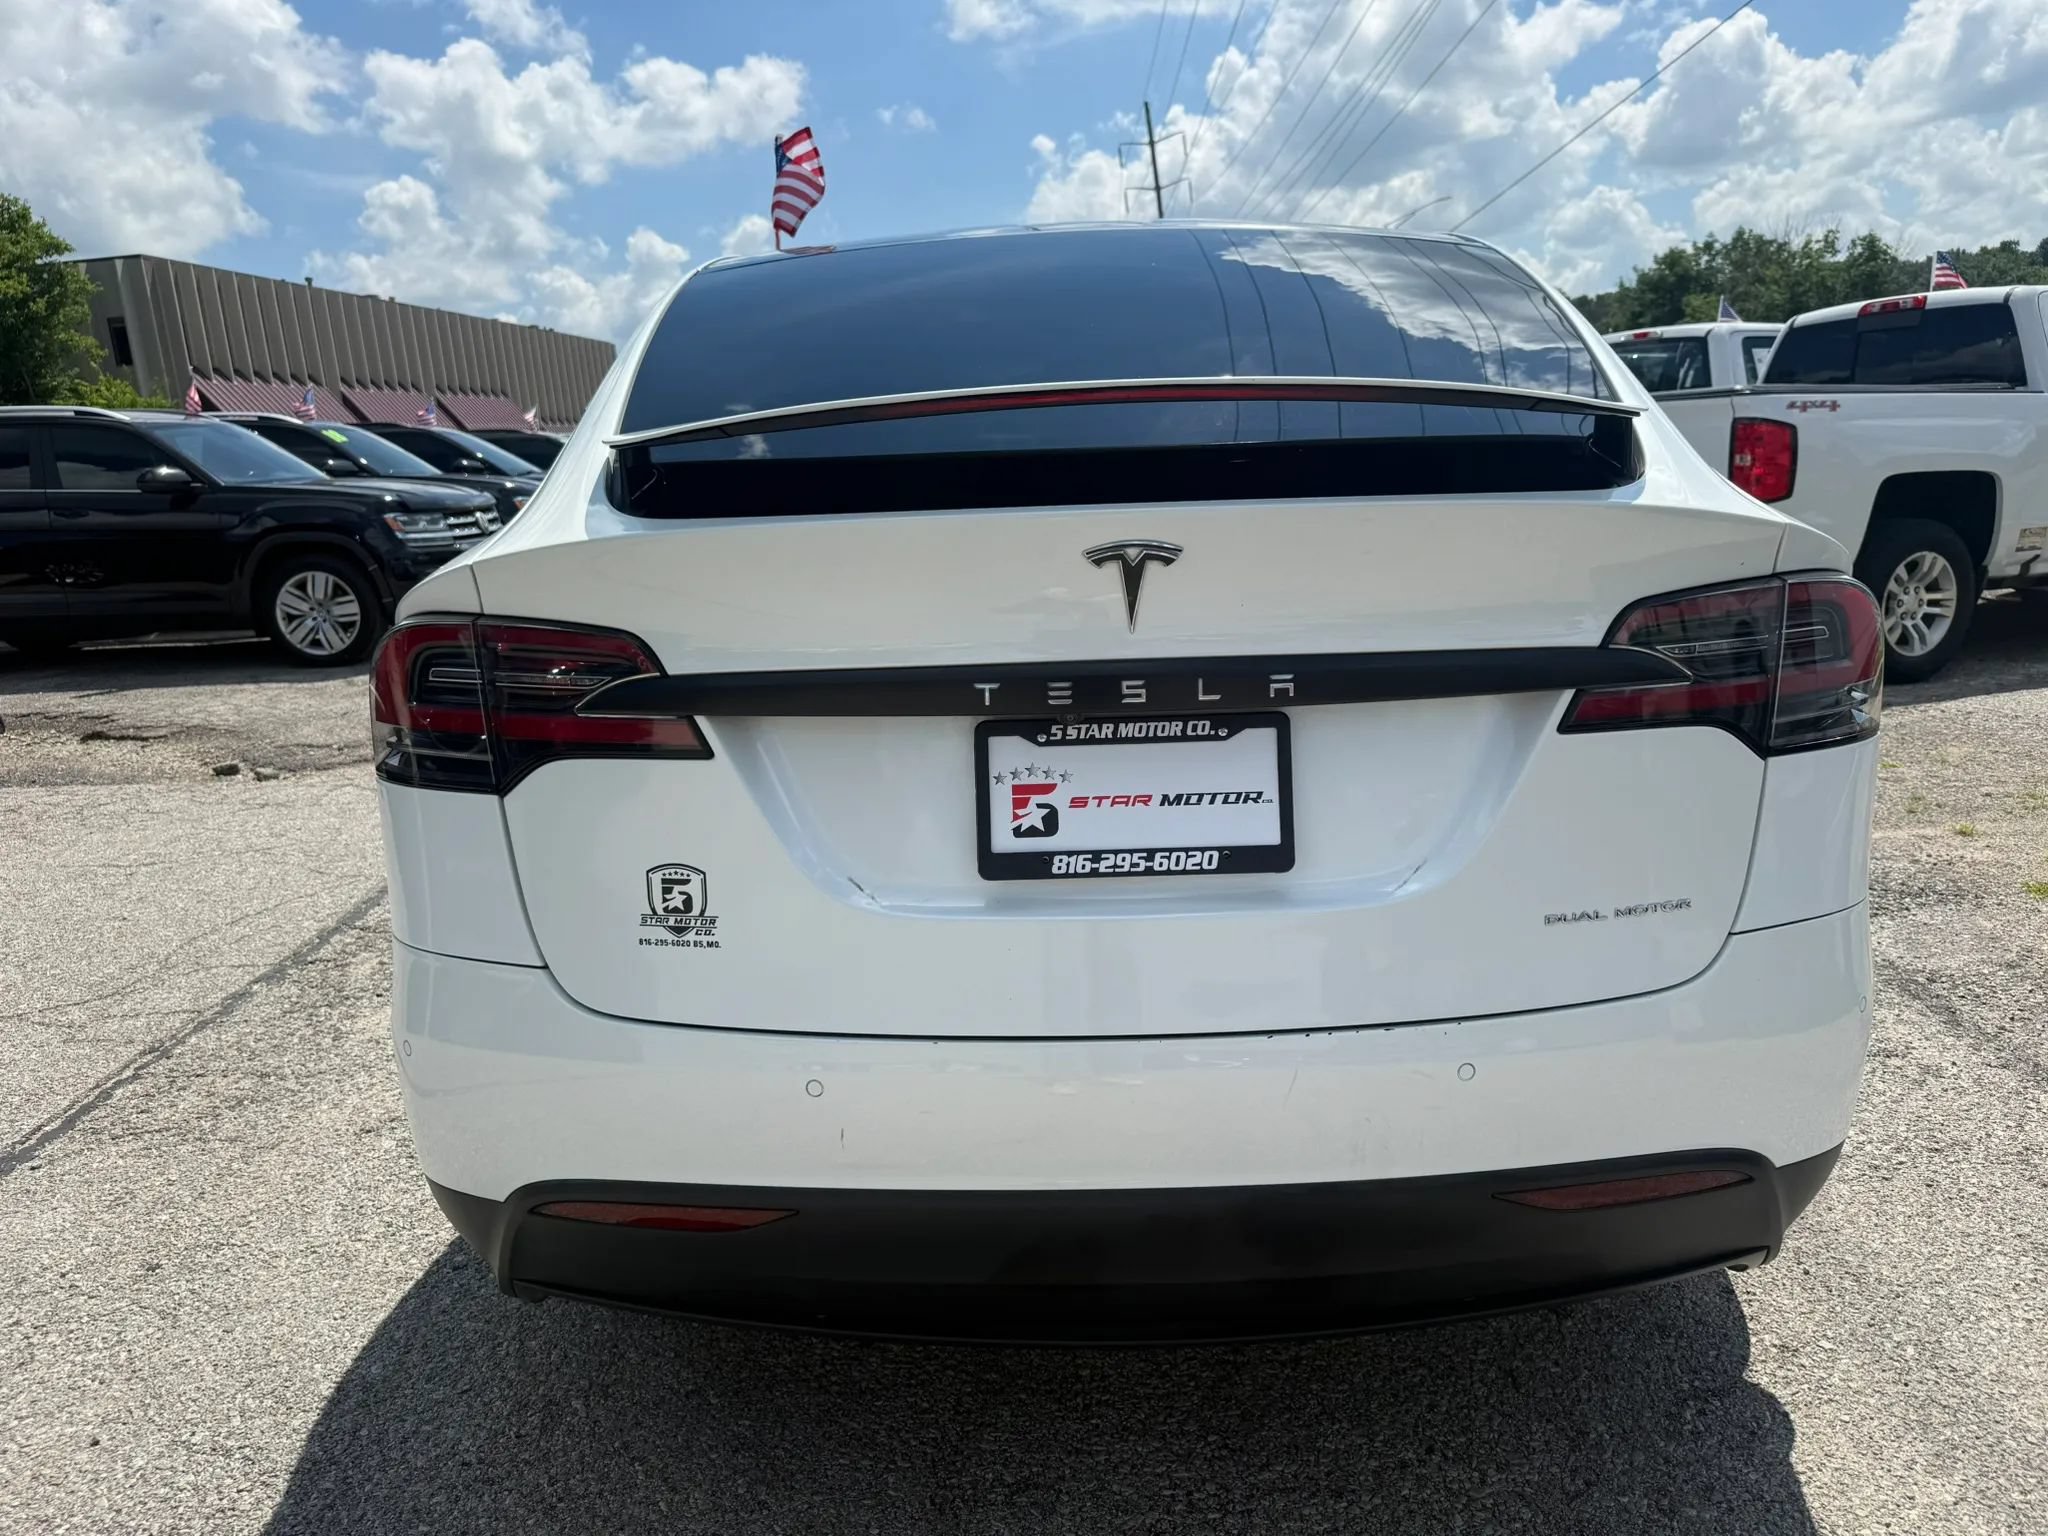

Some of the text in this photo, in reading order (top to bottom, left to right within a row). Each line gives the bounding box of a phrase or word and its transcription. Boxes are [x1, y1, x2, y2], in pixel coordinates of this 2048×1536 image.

[973, 673, 1295, 706] TESLA
[1050, 720, 1215, 740] 5 STAR MOTOR CO.
[1068, 794, 1153, 808] STAR
[1159, 791, 1264, 806] MOTOR
[1051, 850, 1219, 874] 816-295-6020
[641, 916, 717, 926] STAR MOTOR
[1544, 898, 1692, 926] DUAL MOTOR
[639, 938, 691, 947] 816-295-6020
